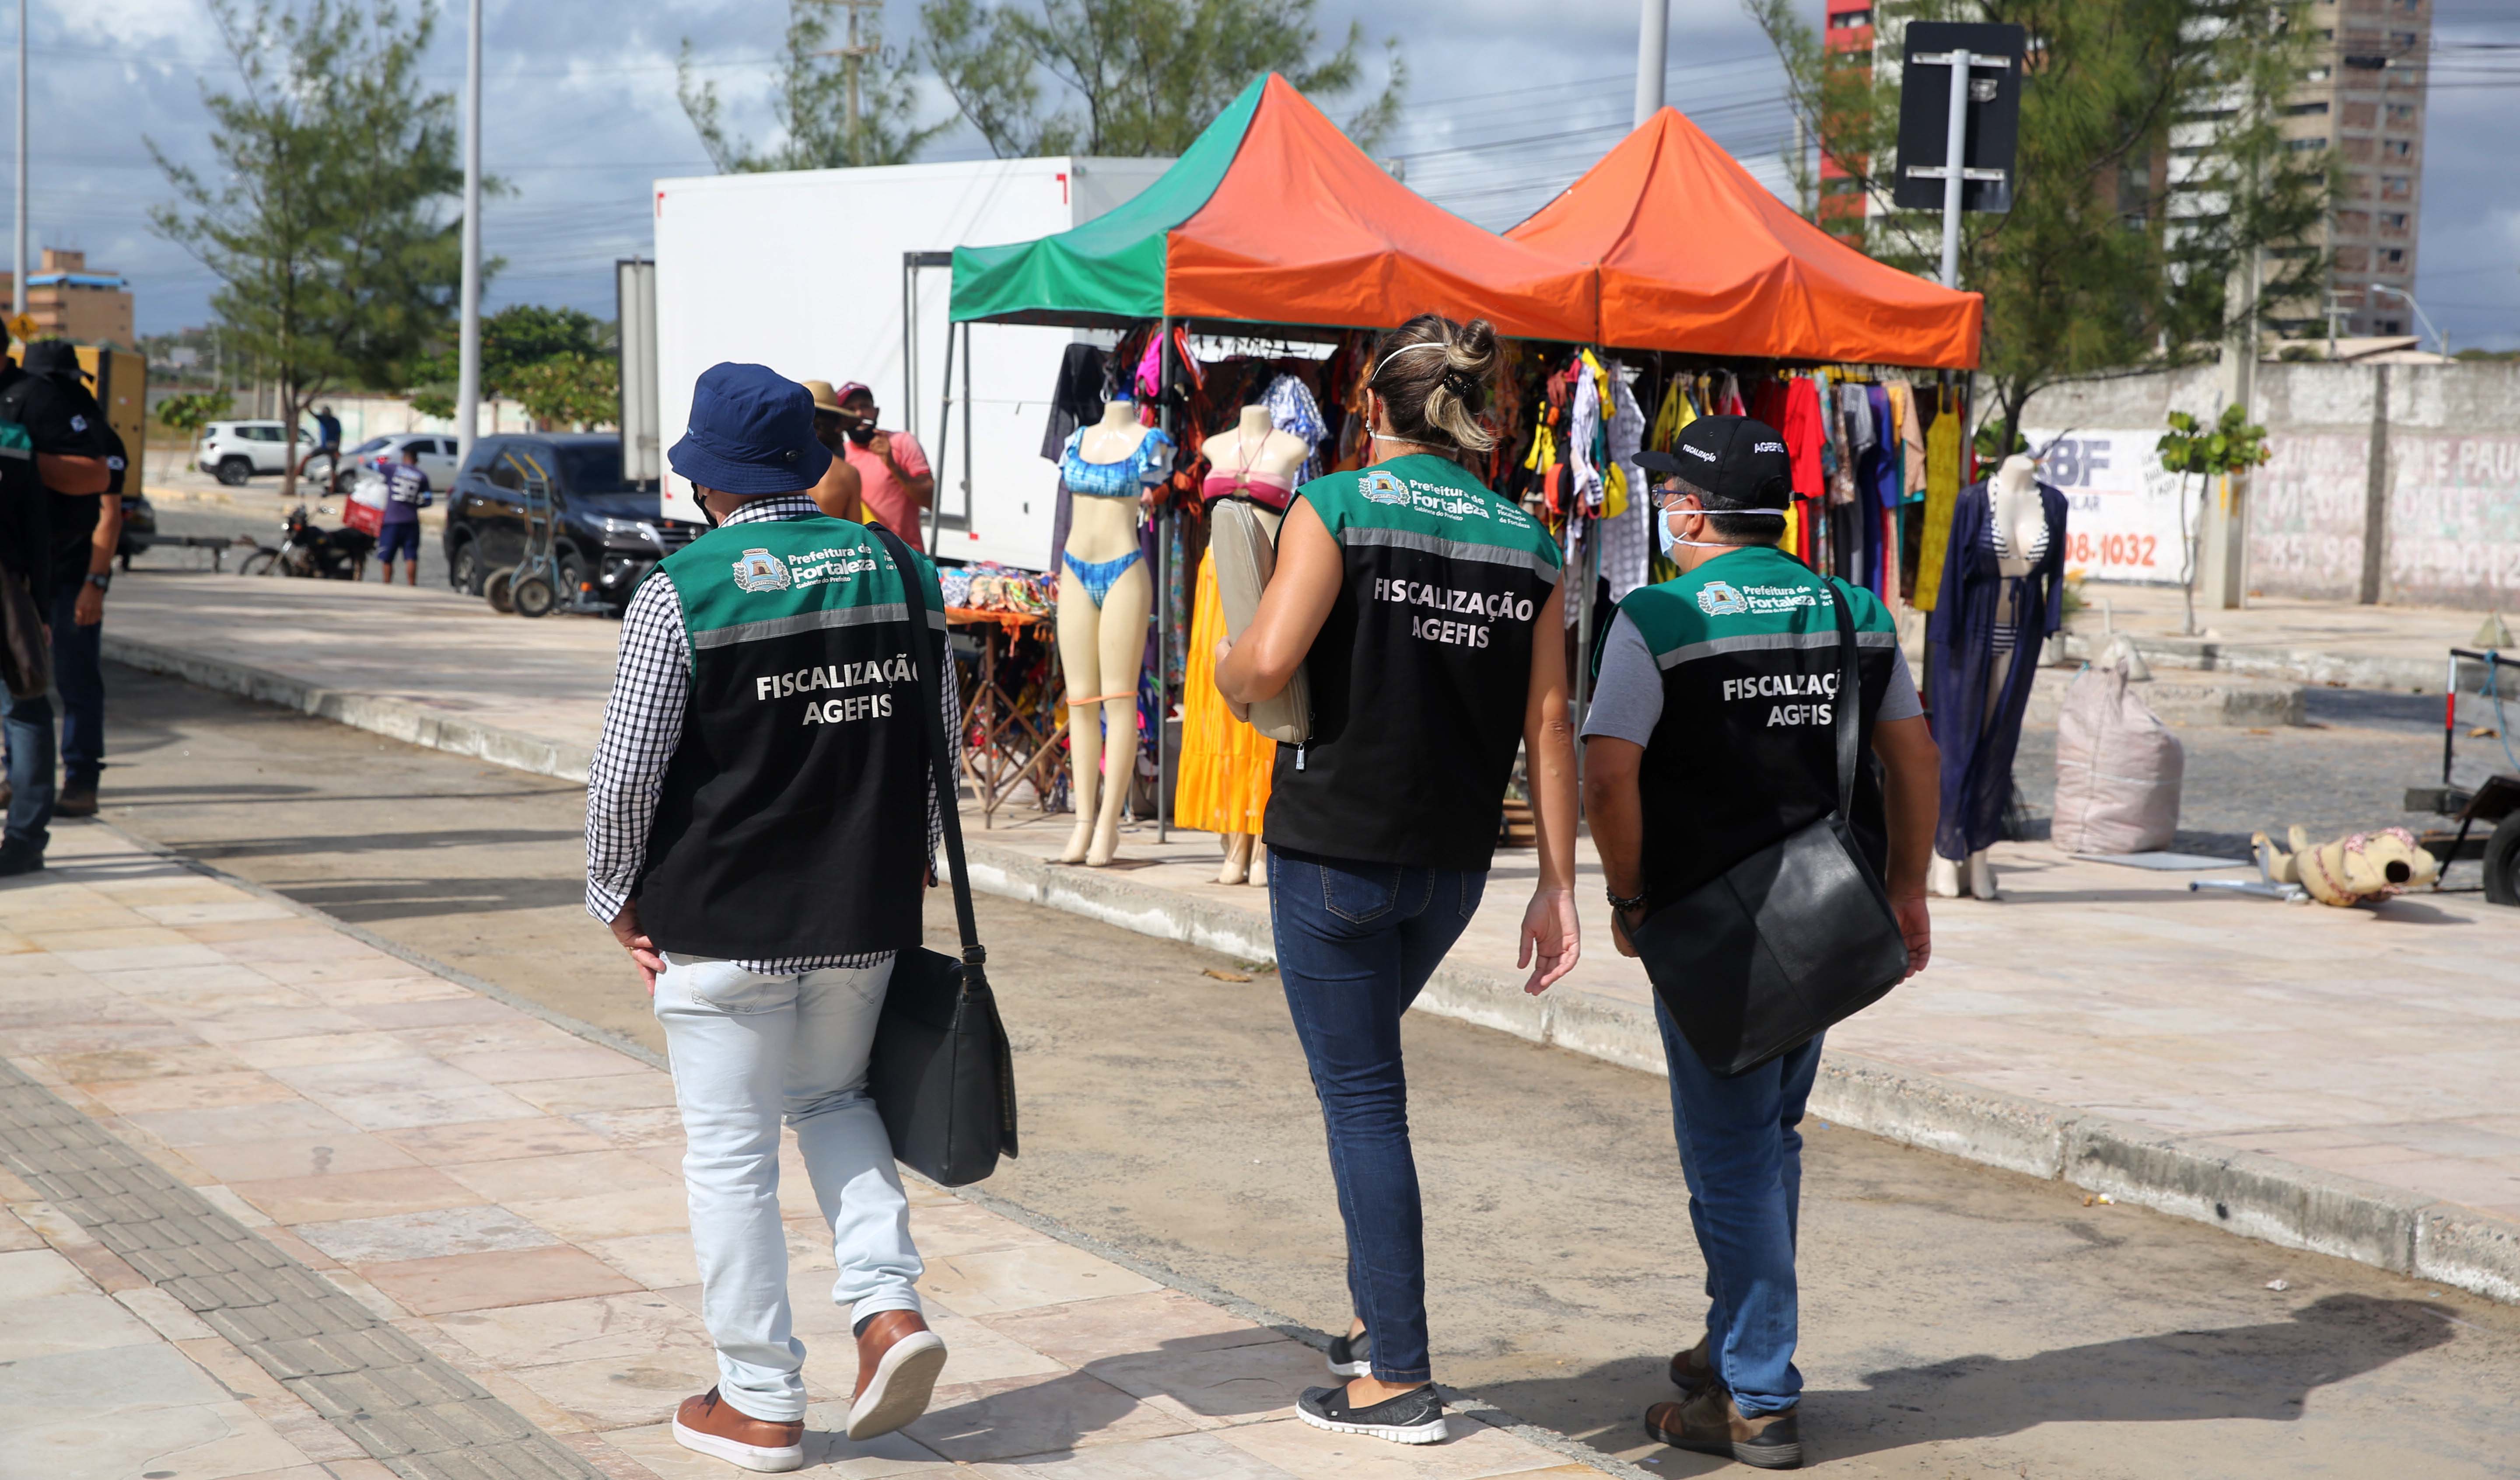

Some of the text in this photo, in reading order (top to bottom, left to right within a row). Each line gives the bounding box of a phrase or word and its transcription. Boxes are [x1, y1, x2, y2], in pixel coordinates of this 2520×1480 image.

[1683, 444, 1716, 462] FISCALIZAÇÃO
[1754, 442, 1784, 453] AGEFIS
[1410, 479, 1485, 505] Prefeitura de
[1412, 490, 1490, 519] Fortaleza
[788, 548, 856, 565] Prefeitura
[858, 542, 872, 554] de
[791, 558, 877, 583] Fortaleza
[796, 579, 821, 589] Gabinete
[1743, 585, 1795, 596] Prefeitura
[1796, 585, 1811, 593] de
[1374, 578, 1533, 622] FISCALIZAÇÃO
[1747, 595, 1816, 608] Fortaleza
[1412, 615, 1490, 648] AGEFIS
[756, 653, 919, 701] FISCALIZAÇÃ
[802, 694, 892, 725] AGEFIS
